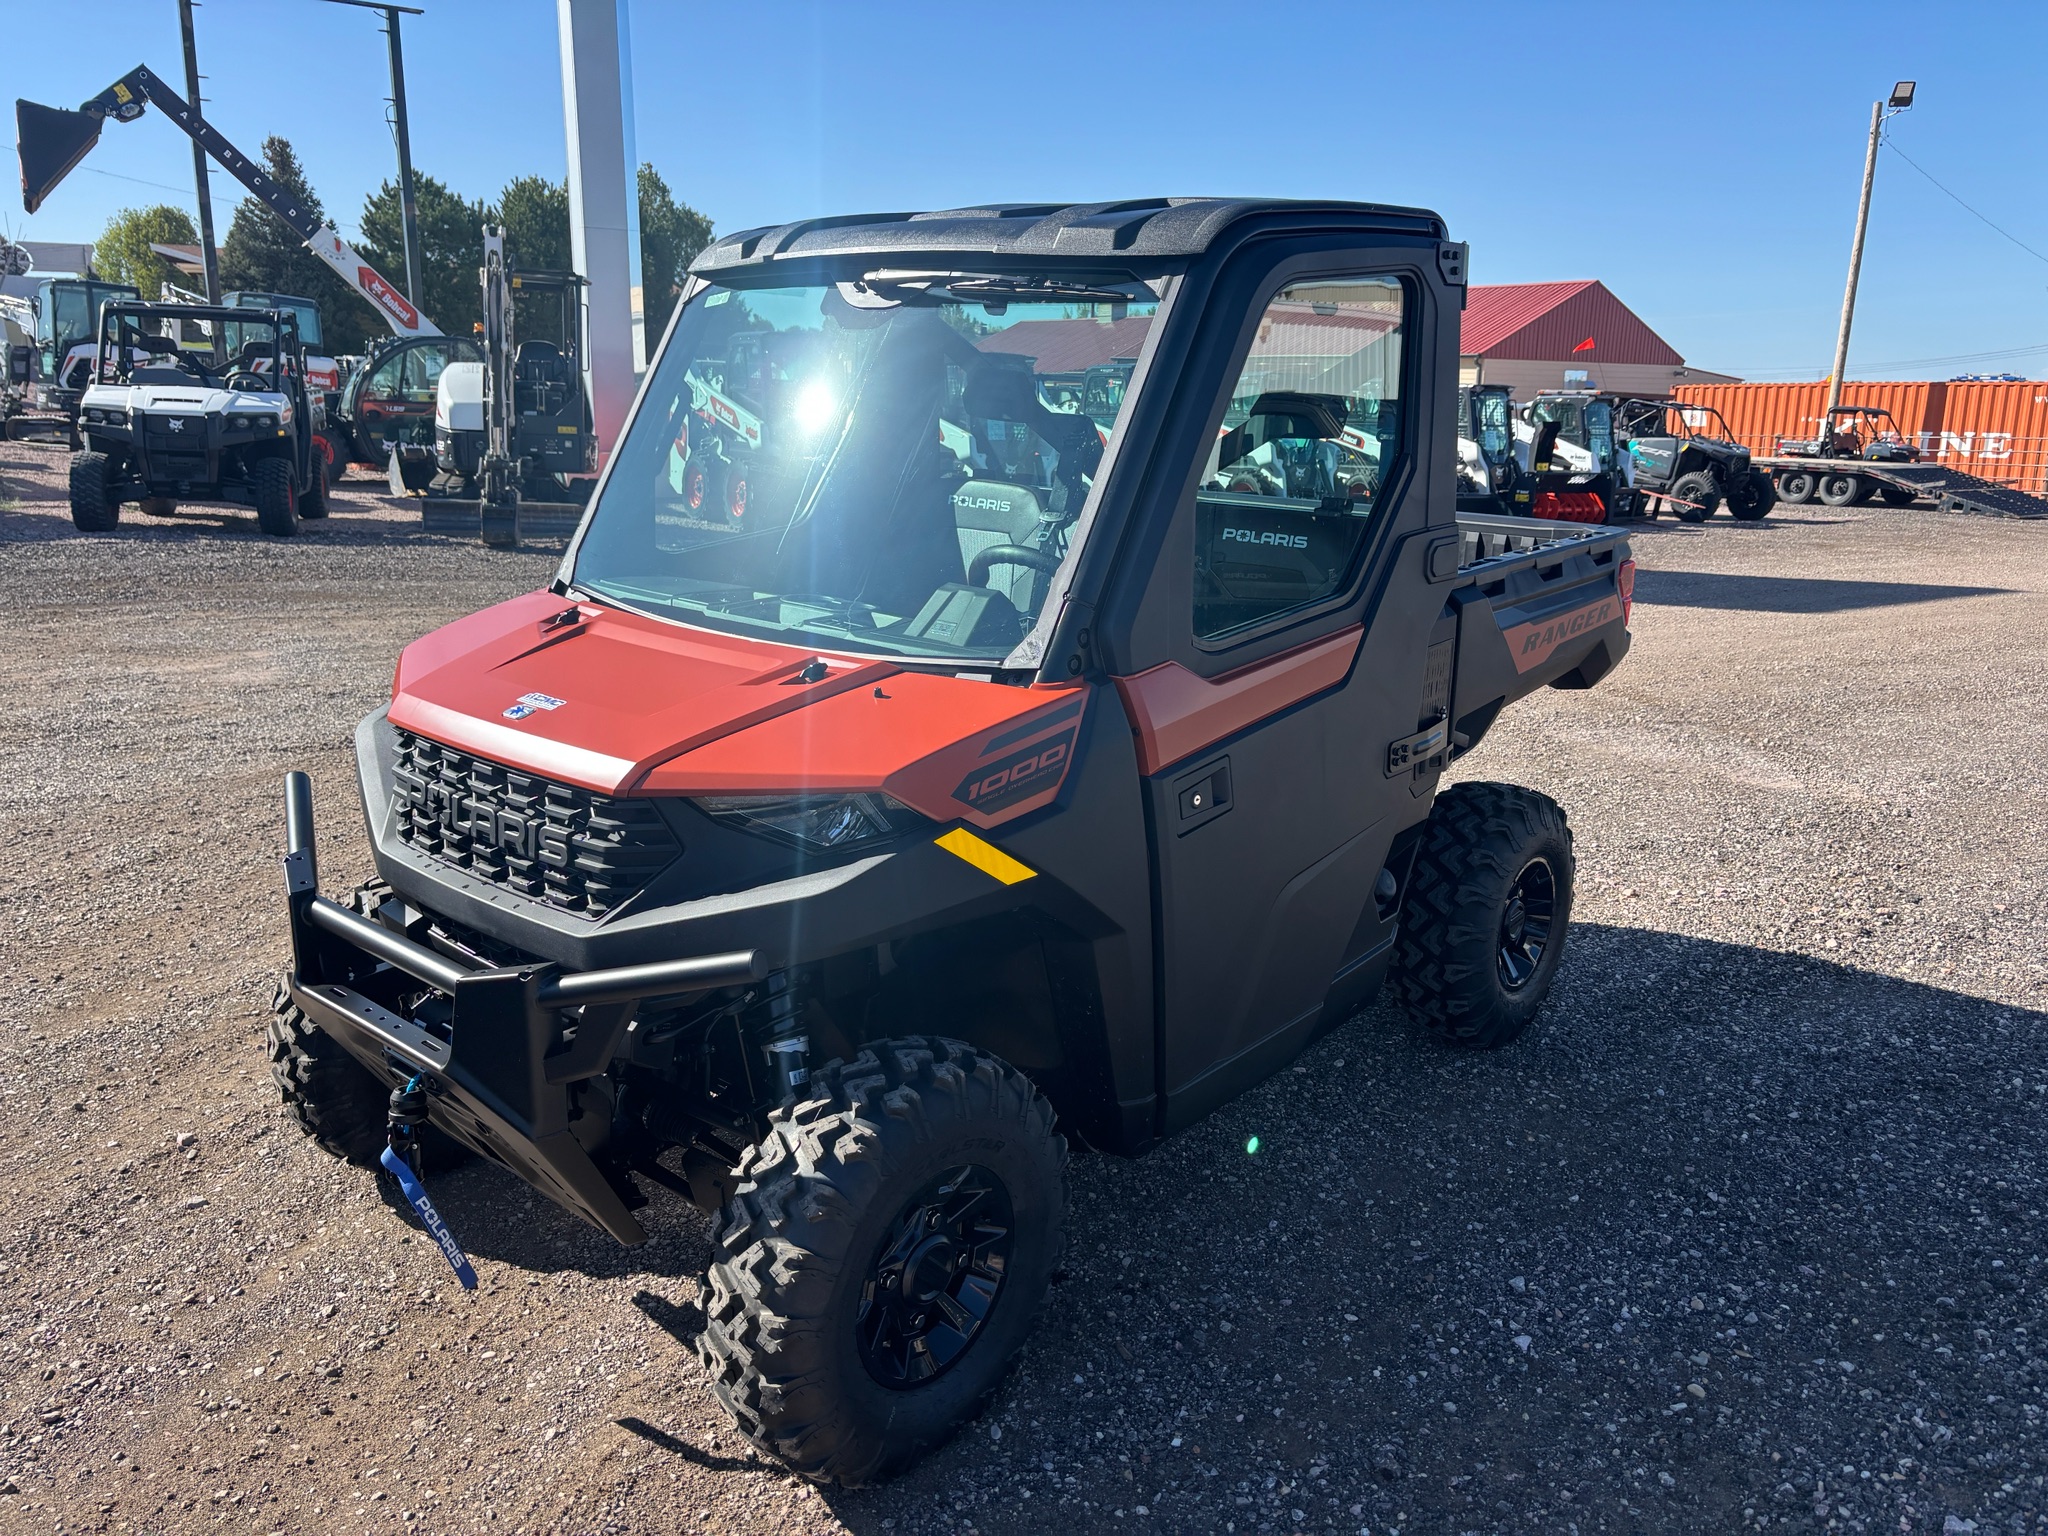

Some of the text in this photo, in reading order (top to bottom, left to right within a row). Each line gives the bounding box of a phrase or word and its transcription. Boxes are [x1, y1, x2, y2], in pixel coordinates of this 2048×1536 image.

[382, 294, 411, 322] Bobcat
[948, 495, 1011, 512] POLARIS
[1222, 528, 1308, 549] POLARIS
[1521, 602, 1612, 655] RANGER
[968, 743, 1066, 801] 1000
[977, 788, 1006, 805] SINGLE
[1008, 770, 1048, 791] OVERHEAD
[407, 770, 574, 868] POLARIS
[415, 1196, 466, 1269] POLARIS
